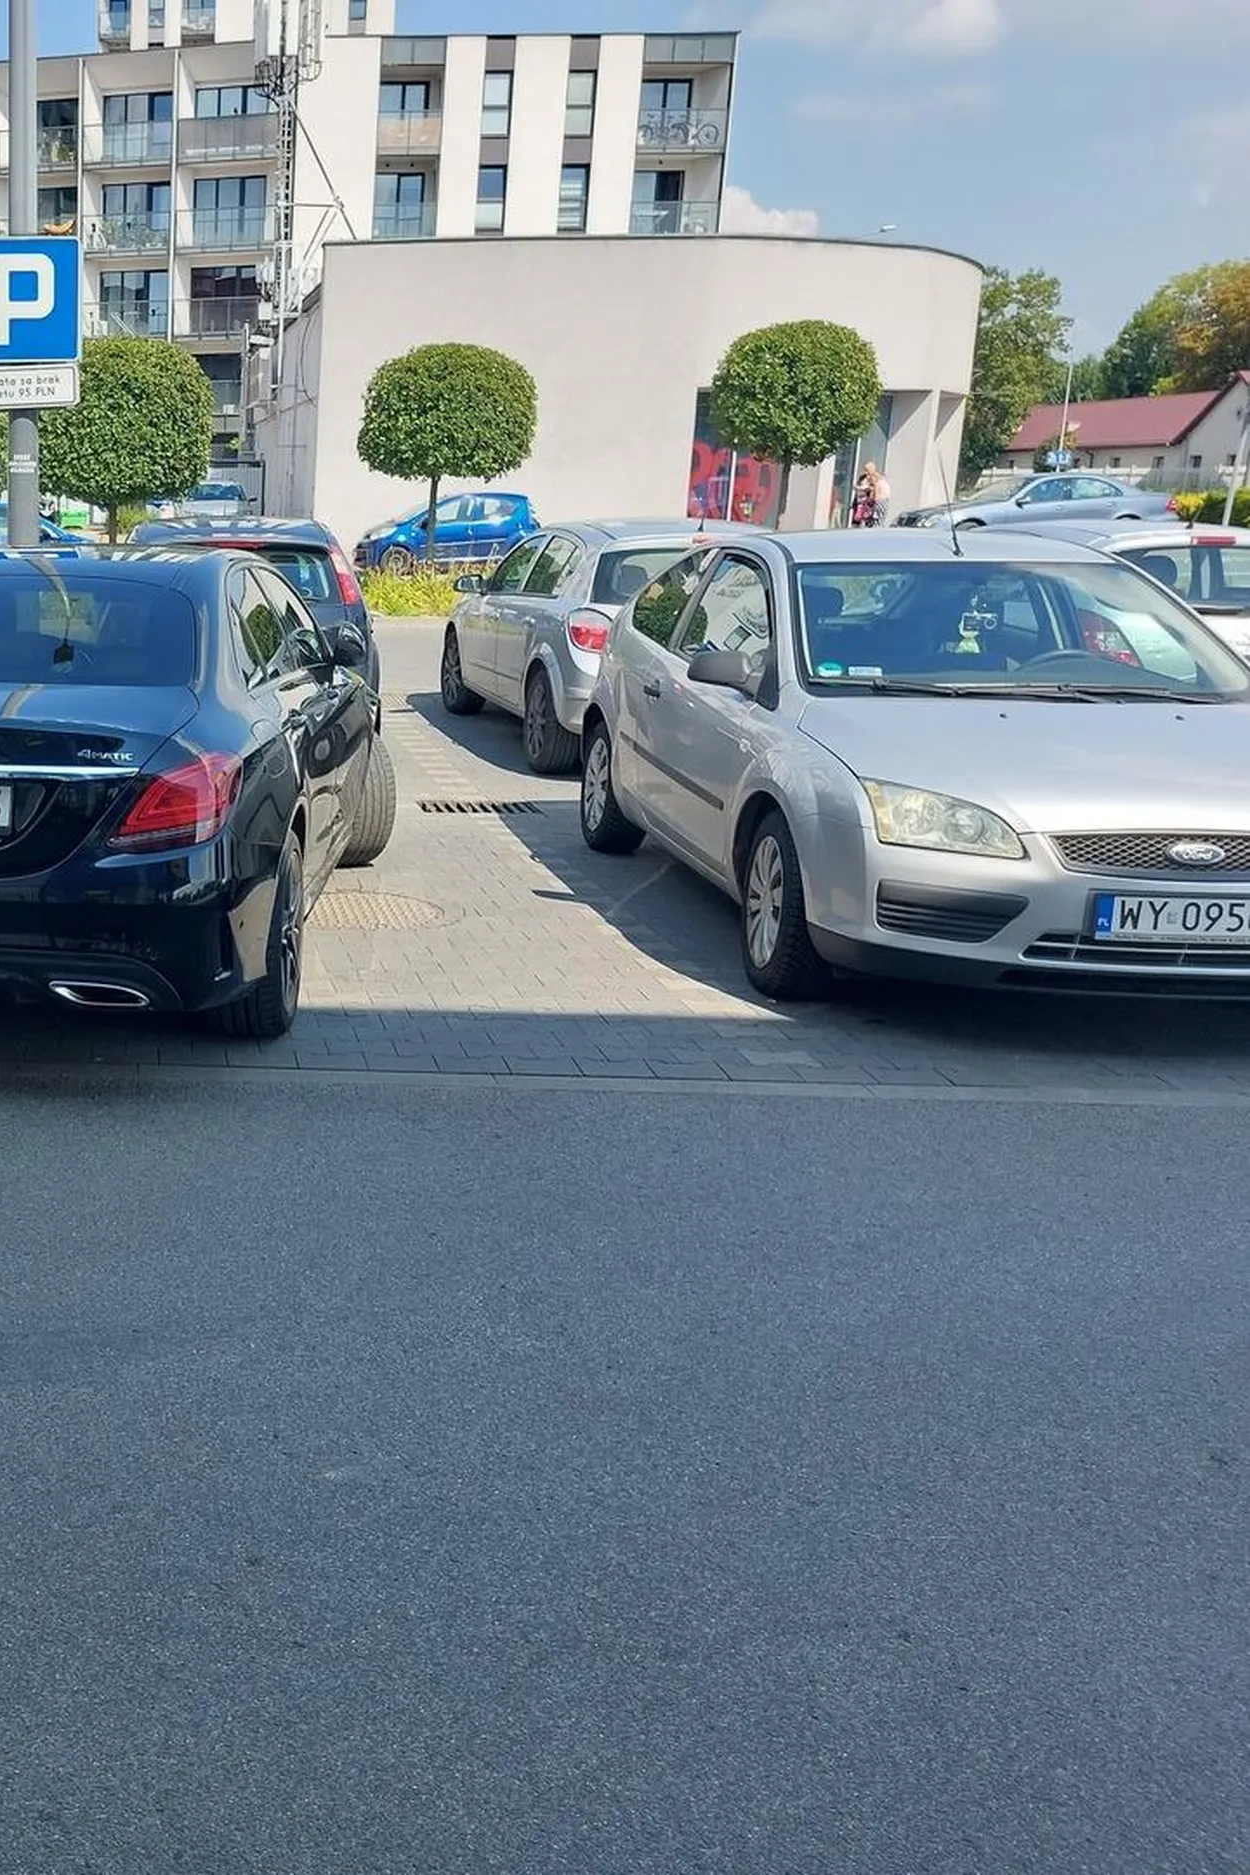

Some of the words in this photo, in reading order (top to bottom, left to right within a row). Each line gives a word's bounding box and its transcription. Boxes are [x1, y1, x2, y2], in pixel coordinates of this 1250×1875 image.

[36, 375, 61, 385] brak
[18, 388, 32, 397] 95
[36, 386, 56, 397] PLN
[1119, 900, 1169, 931] WY
[1182, 901, 1250, 932] 095
